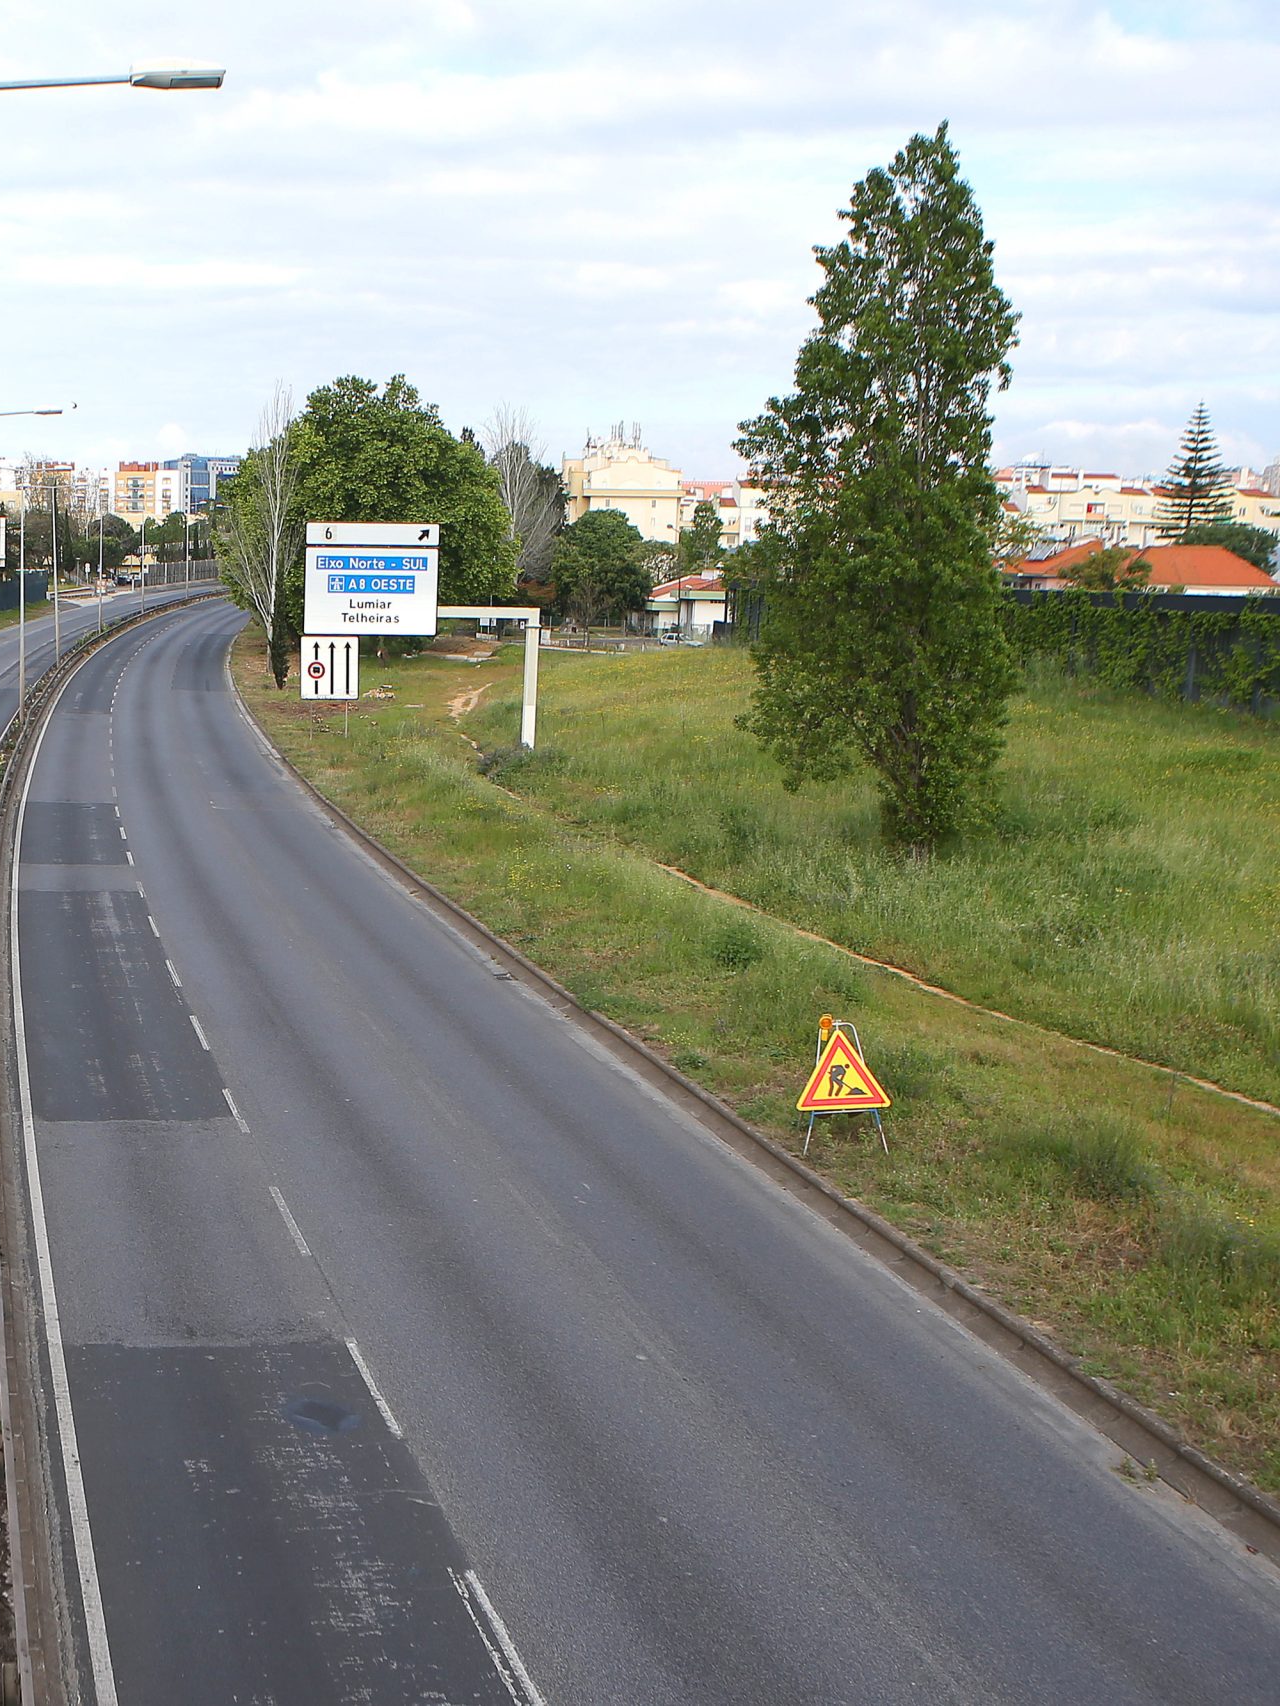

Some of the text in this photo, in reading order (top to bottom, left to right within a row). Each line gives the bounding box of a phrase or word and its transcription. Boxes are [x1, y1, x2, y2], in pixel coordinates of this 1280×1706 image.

[325, 527, 332, 540] 6
[349, 558, 385, 569] Norte
[402, 558, 426, 570] SUL
[348, 579, 414, 590] A8 OESTE
[349, 599, 392, 609] Lumiar
[341, 612, 400, 623] Telheiras
